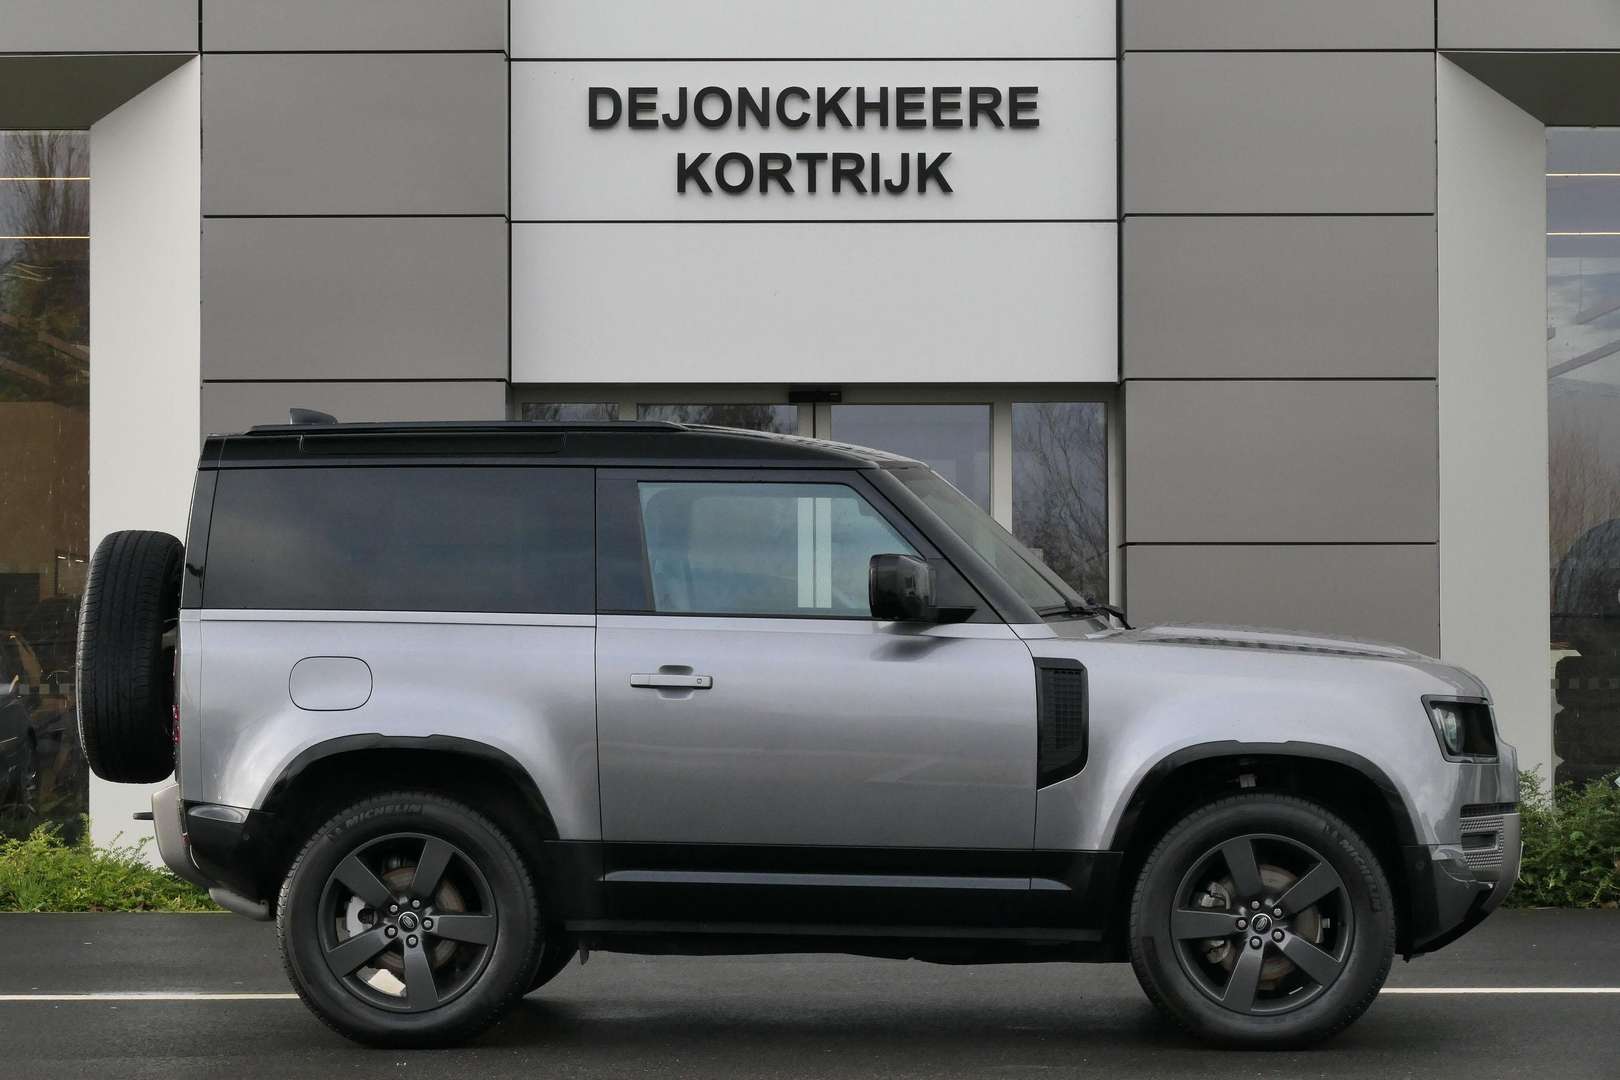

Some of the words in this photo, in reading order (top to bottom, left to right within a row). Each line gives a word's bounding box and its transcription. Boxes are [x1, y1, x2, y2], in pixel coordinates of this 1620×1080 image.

[588, 86, 1039, 128] DEJONCKHEERE
[676, 152, 953, 193] KORTRIJK
[345, 803, 422, 828] MICHELIN
